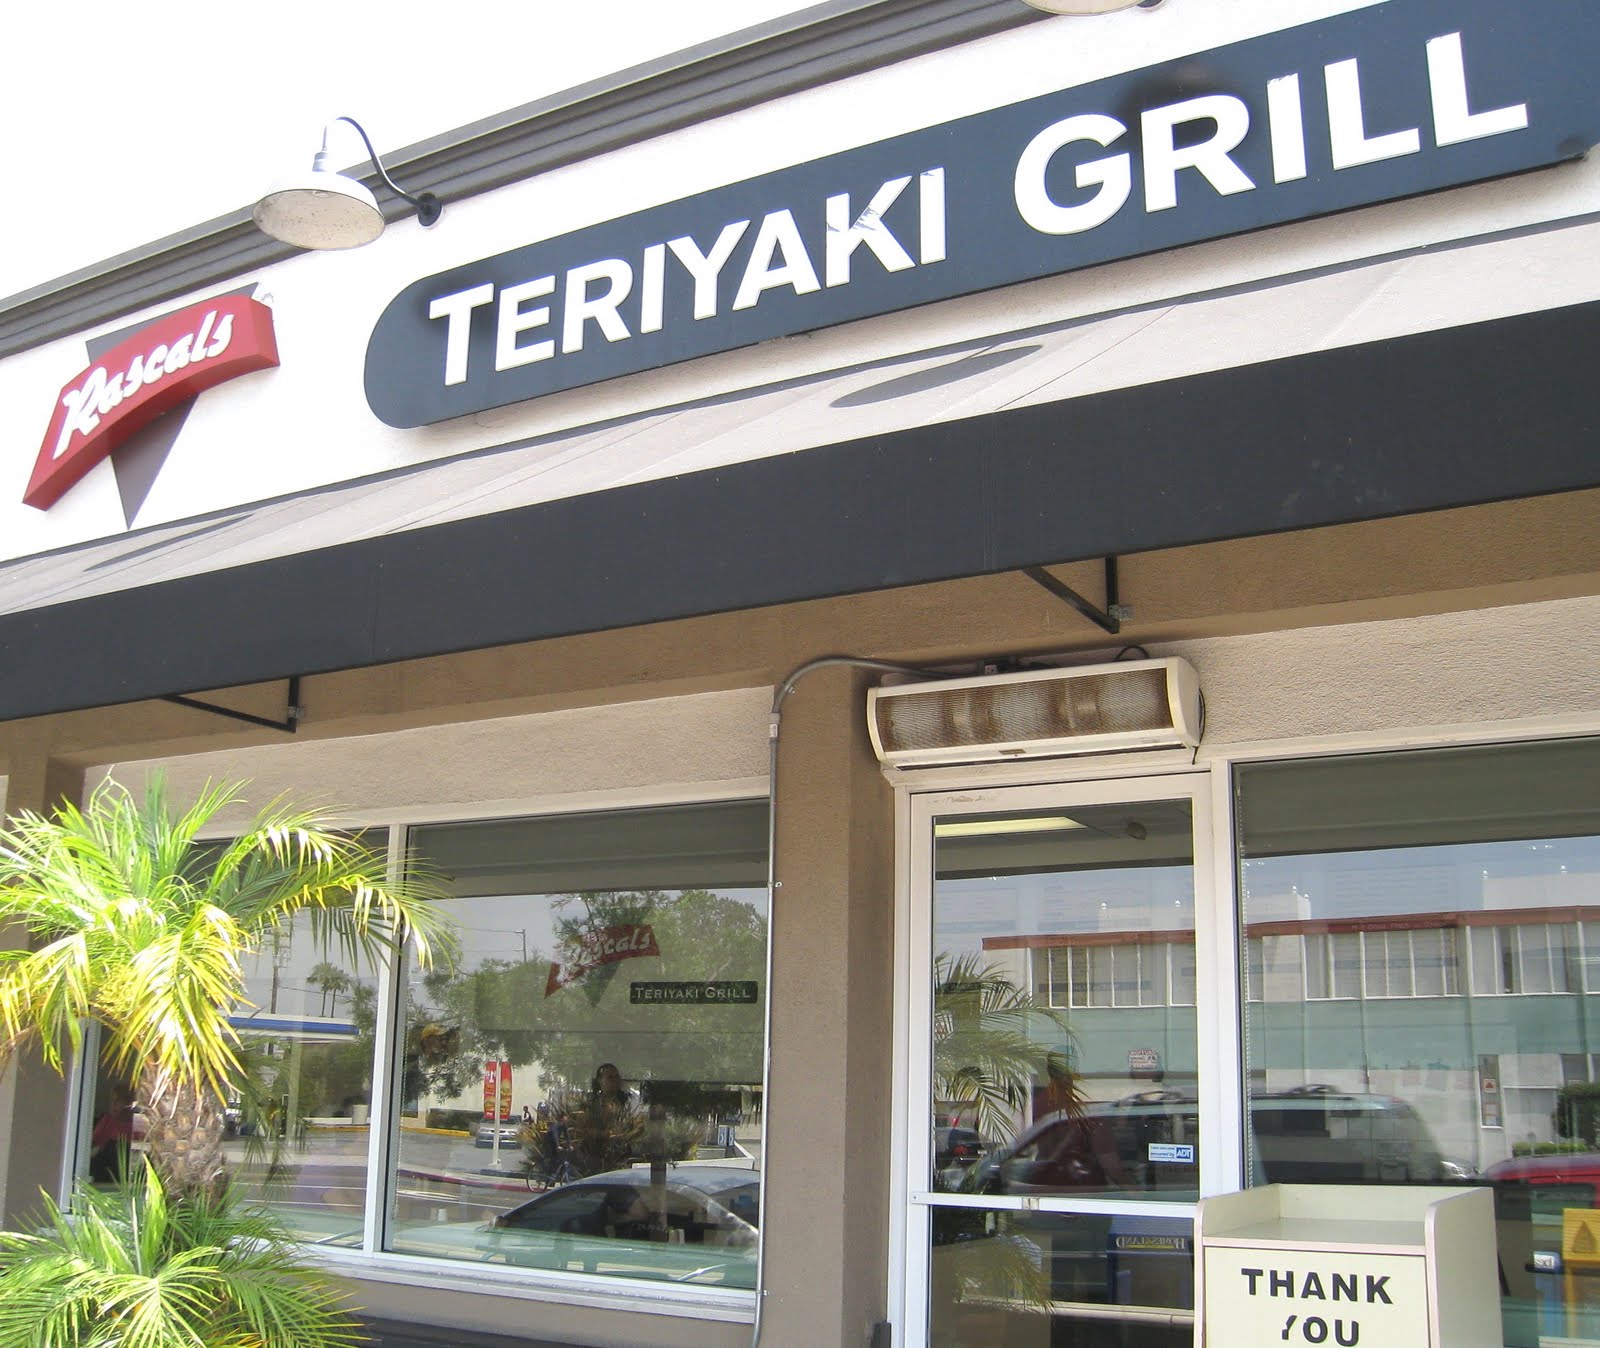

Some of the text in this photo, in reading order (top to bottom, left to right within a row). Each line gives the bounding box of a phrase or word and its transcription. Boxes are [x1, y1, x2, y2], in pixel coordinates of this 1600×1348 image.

[428, 31, 1528, 387] TERIYAKI GRILL
[52, 309, 235, 461] Rascals
[634, 986, 751, 999] TERIYAKI GRILL
[1176, 1148, 1191, 1158] ADT
[1240, 1267, 1394, 1305] THANK
[1281, 1314, 1360, 1347] YOU
